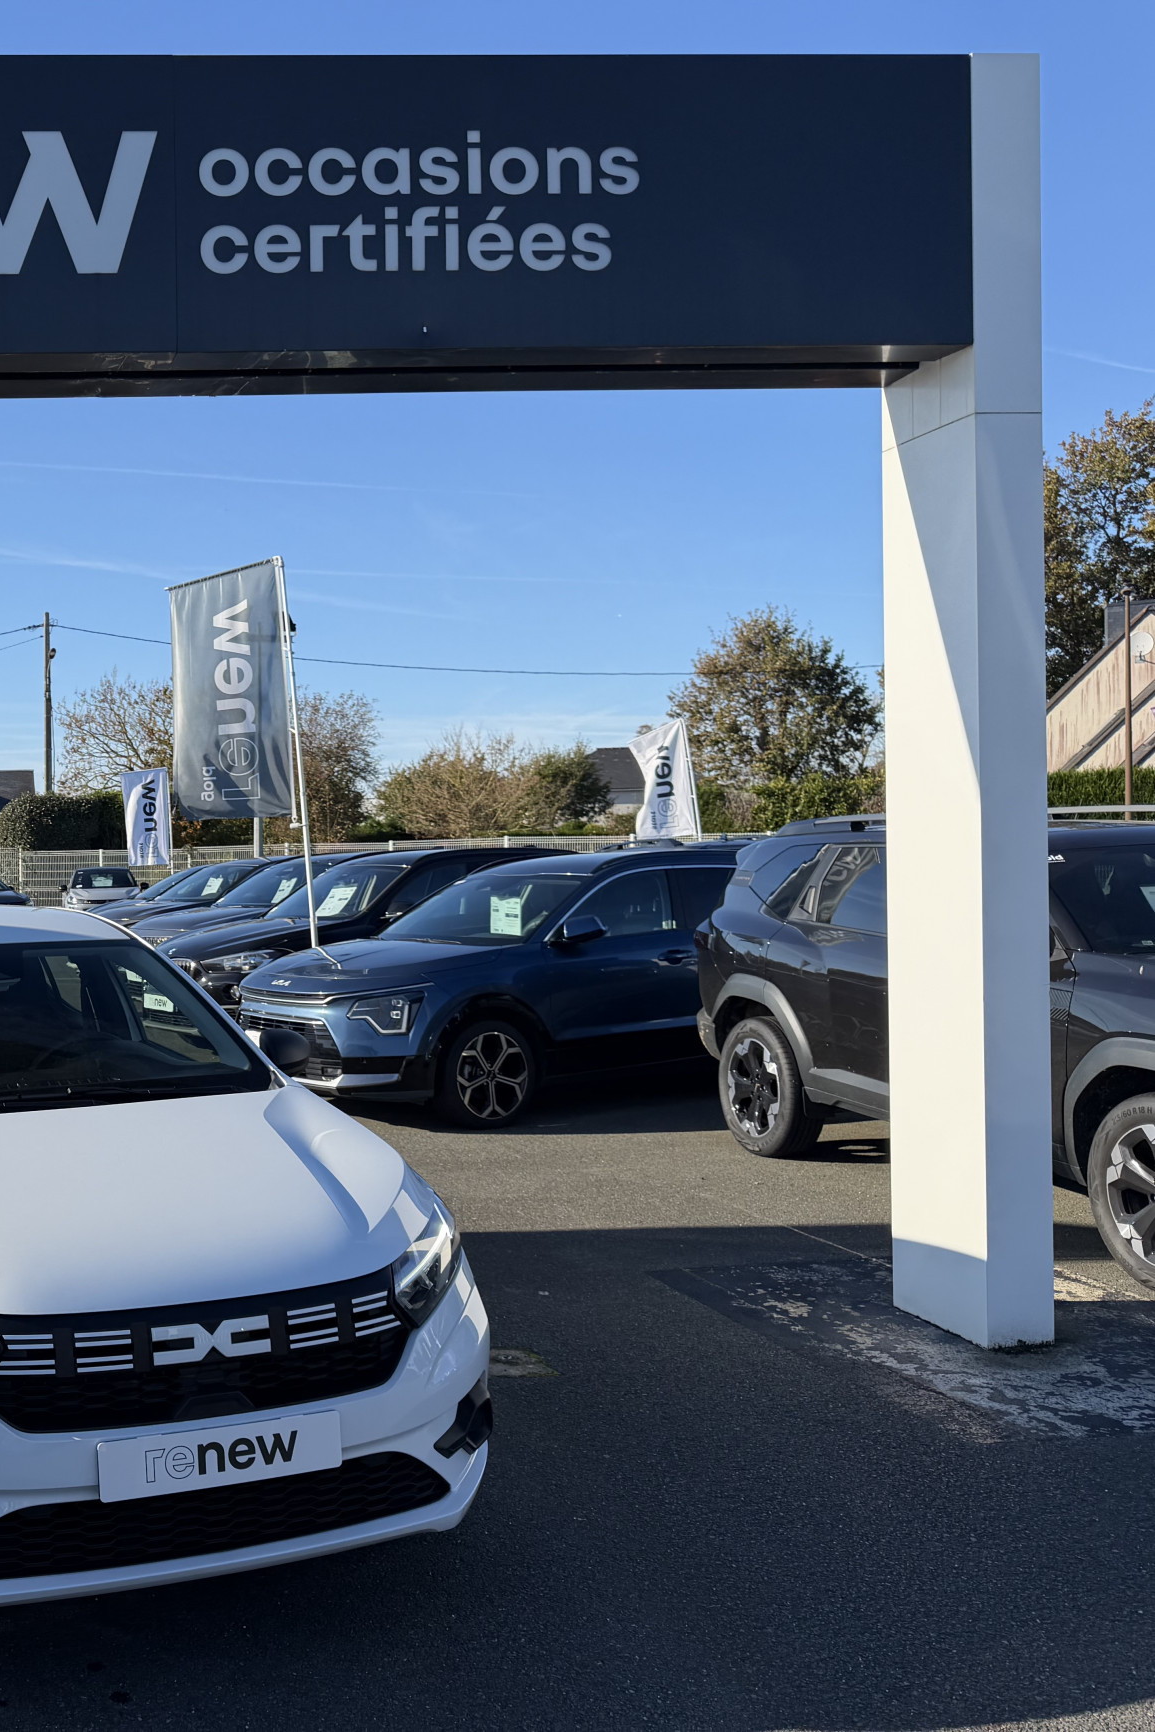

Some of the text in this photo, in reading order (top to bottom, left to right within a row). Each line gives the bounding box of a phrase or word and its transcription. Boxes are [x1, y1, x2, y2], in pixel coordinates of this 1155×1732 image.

[198, 129, 641, 197] occasions
[199, 205, 613, 275] certifiées
[144, 1429, 299, 1484] renew
